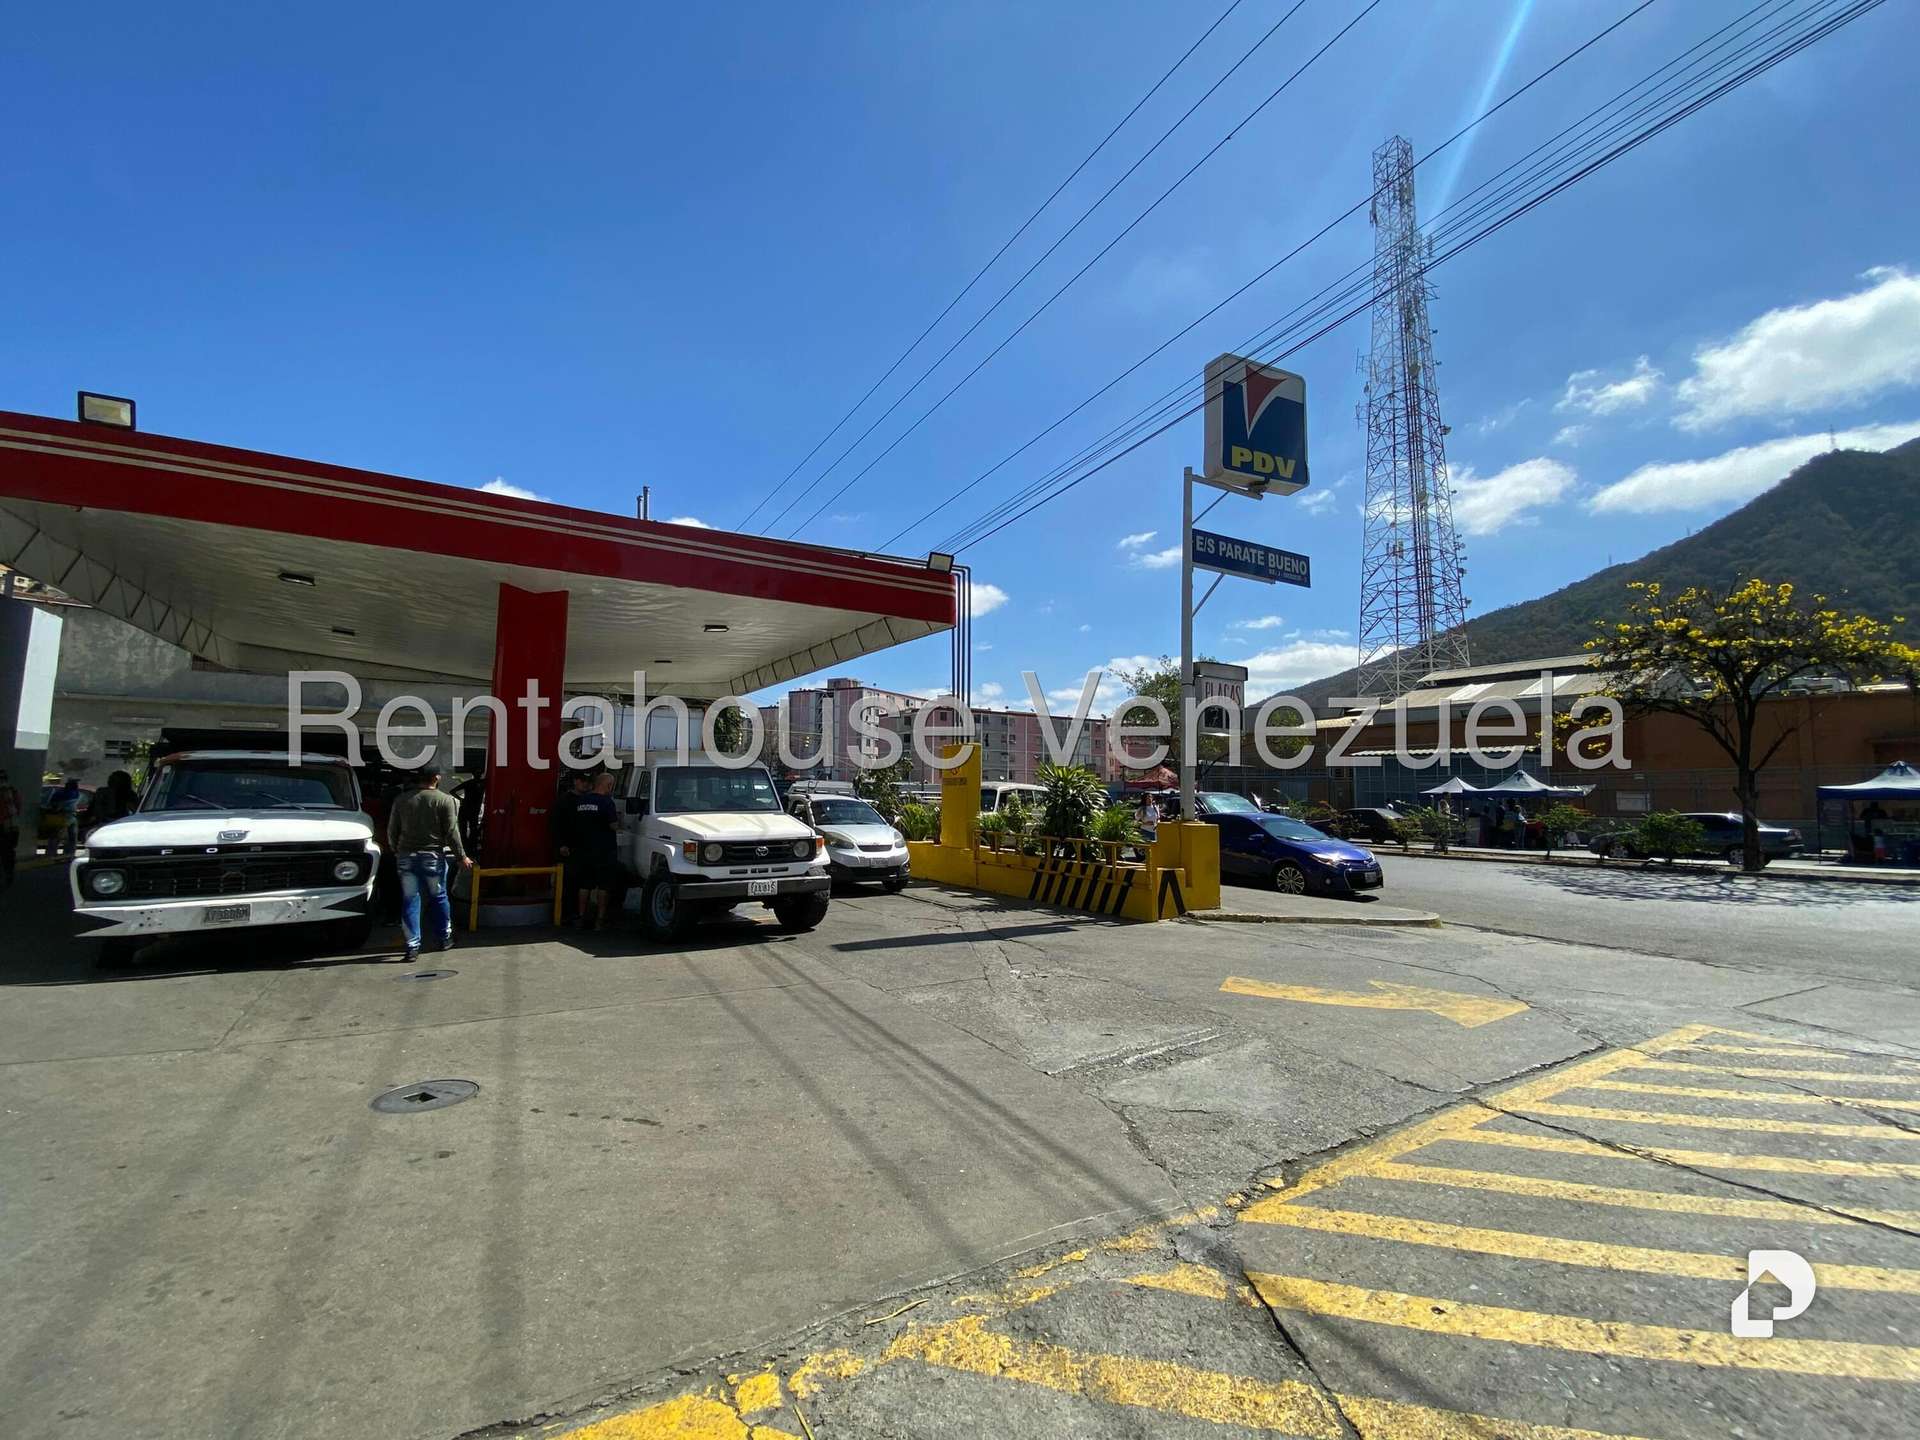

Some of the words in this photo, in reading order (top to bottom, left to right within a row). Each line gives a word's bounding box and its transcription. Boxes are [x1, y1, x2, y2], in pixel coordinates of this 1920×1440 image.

[1231, 445, 1297, 479] PDV
[1195, 535, 1216, 554] E/S
[1218, 541, 1265, 566] PARATE
[1268, 552, 1307, 576] BUENO
